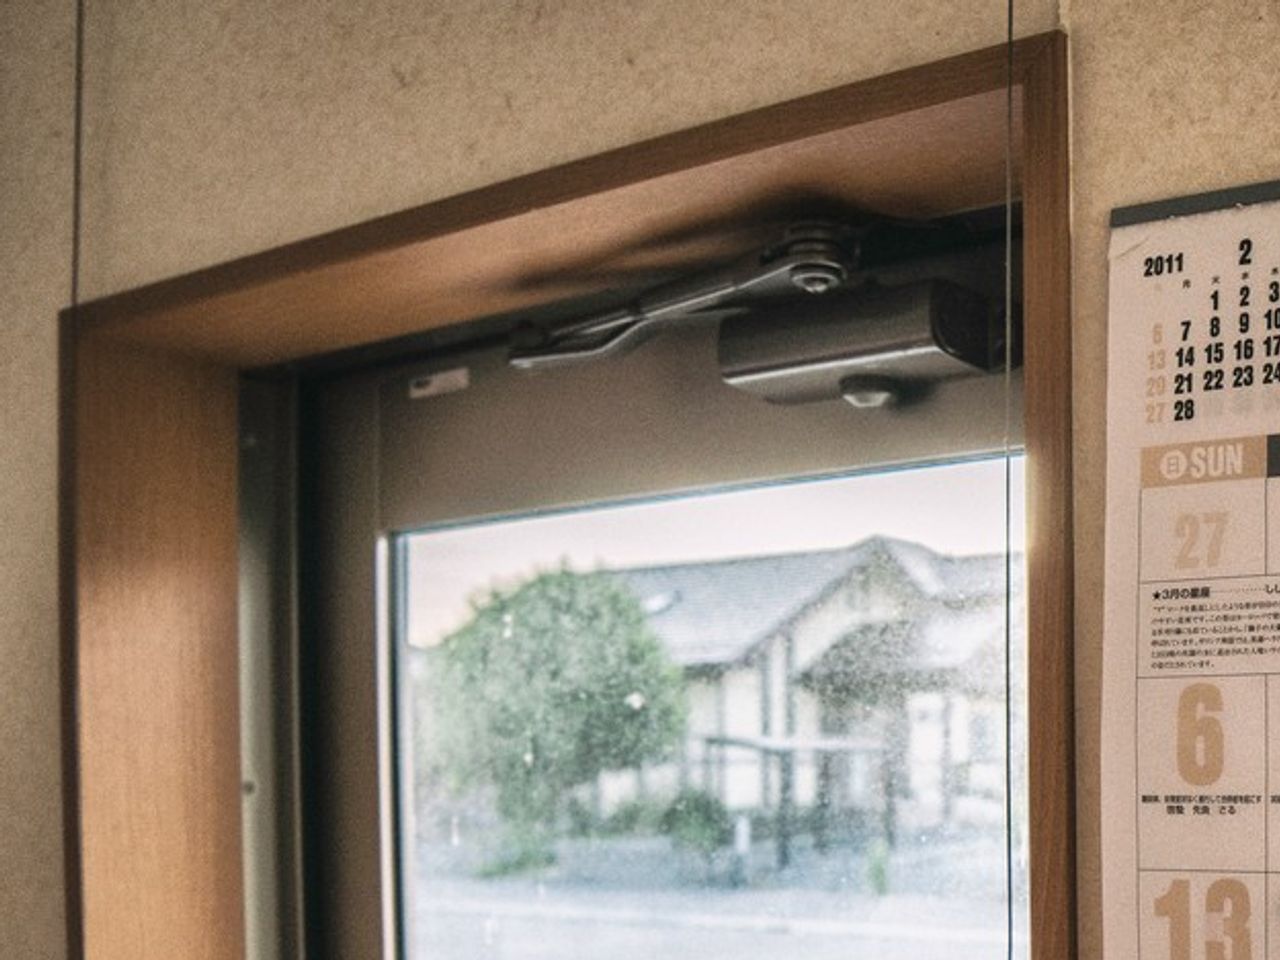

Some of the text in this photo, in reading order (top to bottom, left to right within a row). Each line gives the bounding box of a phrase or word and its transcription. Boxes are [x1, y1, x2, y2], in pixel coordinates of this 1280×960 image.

[1144, 253, 1183, 277] 2011
[1239, 239, 1252, 265] 2
[1211, 290, 1218, 310] 1
[1240, 286, 1250, 307] 2
[1269, 281, 1279, 302] 3
[1181, 321, 1191, 341] 7
[1210, 316, 1220, 337] 8
[1239, 312, 1249, 333] 9
[1176, 346, 1194, 367] 14
[1205, 342, 1224, 364] 15
[1234, 339, 1253, 360] 16
[1174, 373, 1192, 394] 21
[1203, 369, 1224, 391] 22
[1233, 365, 1253, 387] 23
[1174, 399, 1194, 421] 28
[1189, 446, 1243, 477] SUN
[1174, 511, 1228, 570] 27
[1177, 683, 1223, 786] 6
